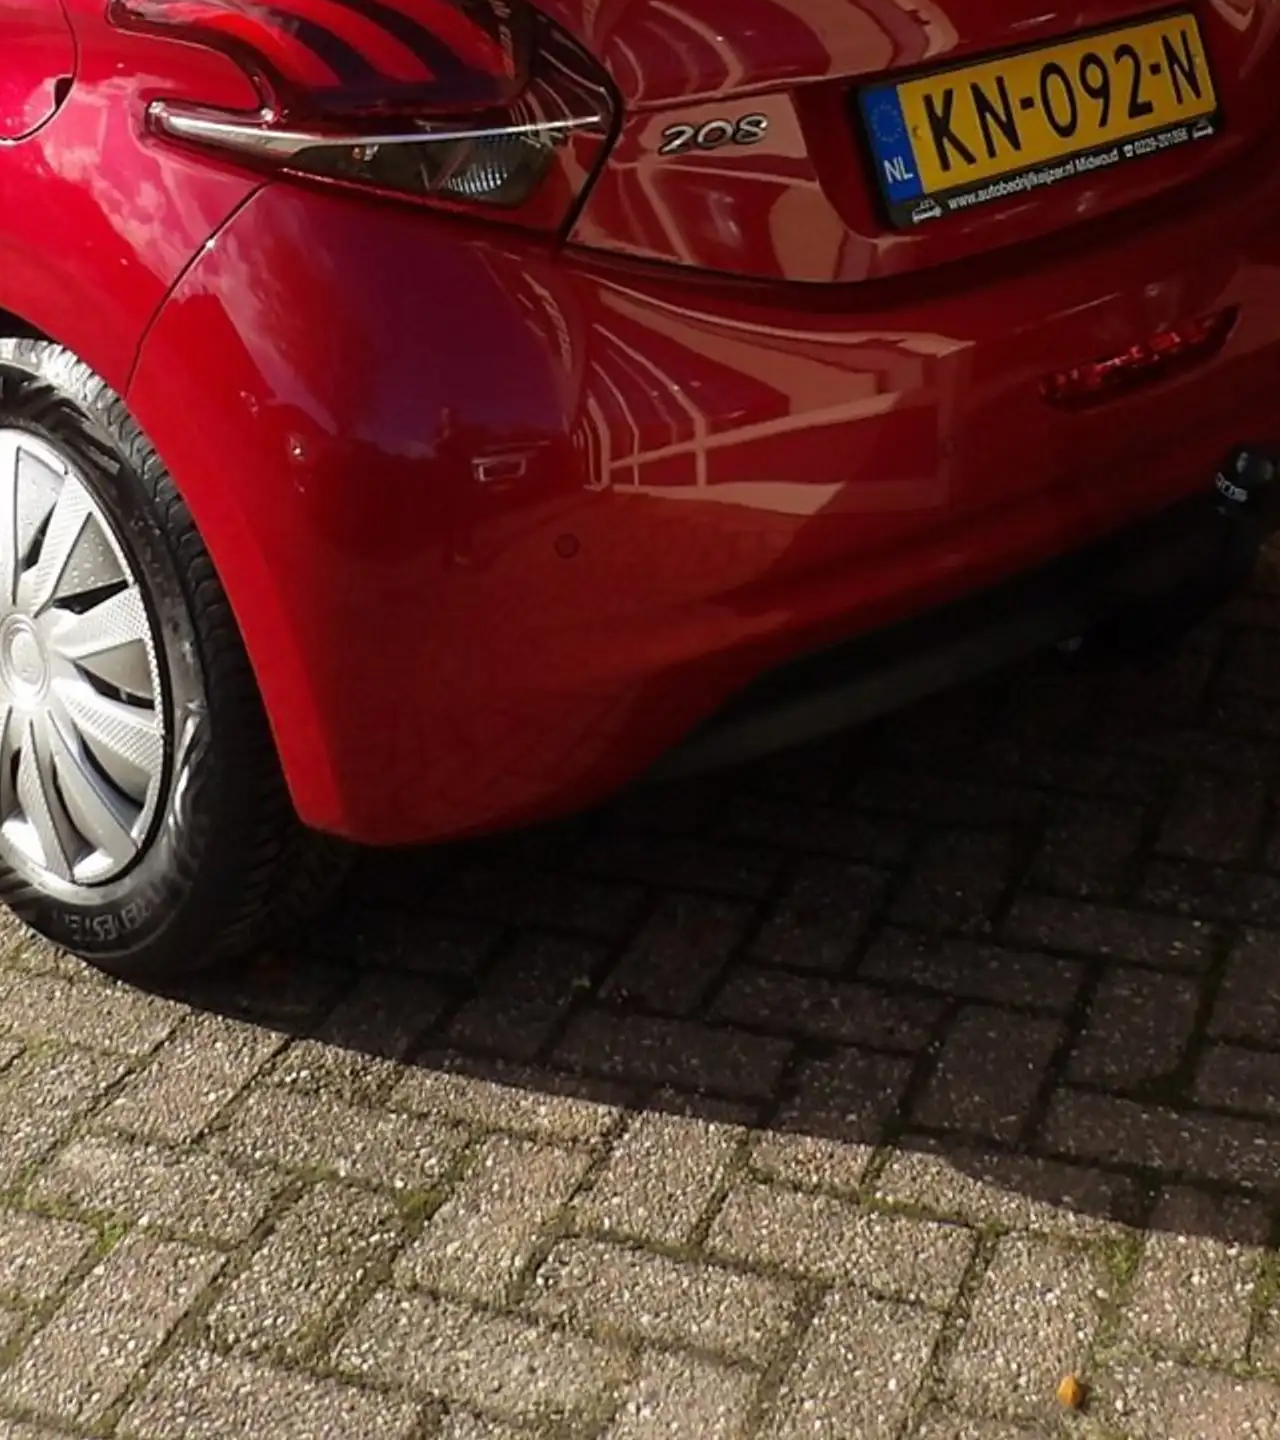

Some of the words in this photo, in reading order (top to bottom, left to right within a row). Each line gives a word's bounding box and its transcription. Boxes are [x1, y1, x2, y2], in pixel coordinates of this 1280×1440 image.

[922, 28, 1203, 173] KN-092-N
[658, 112, 768, 156] 208
[884, 154, 914, 184] NL
